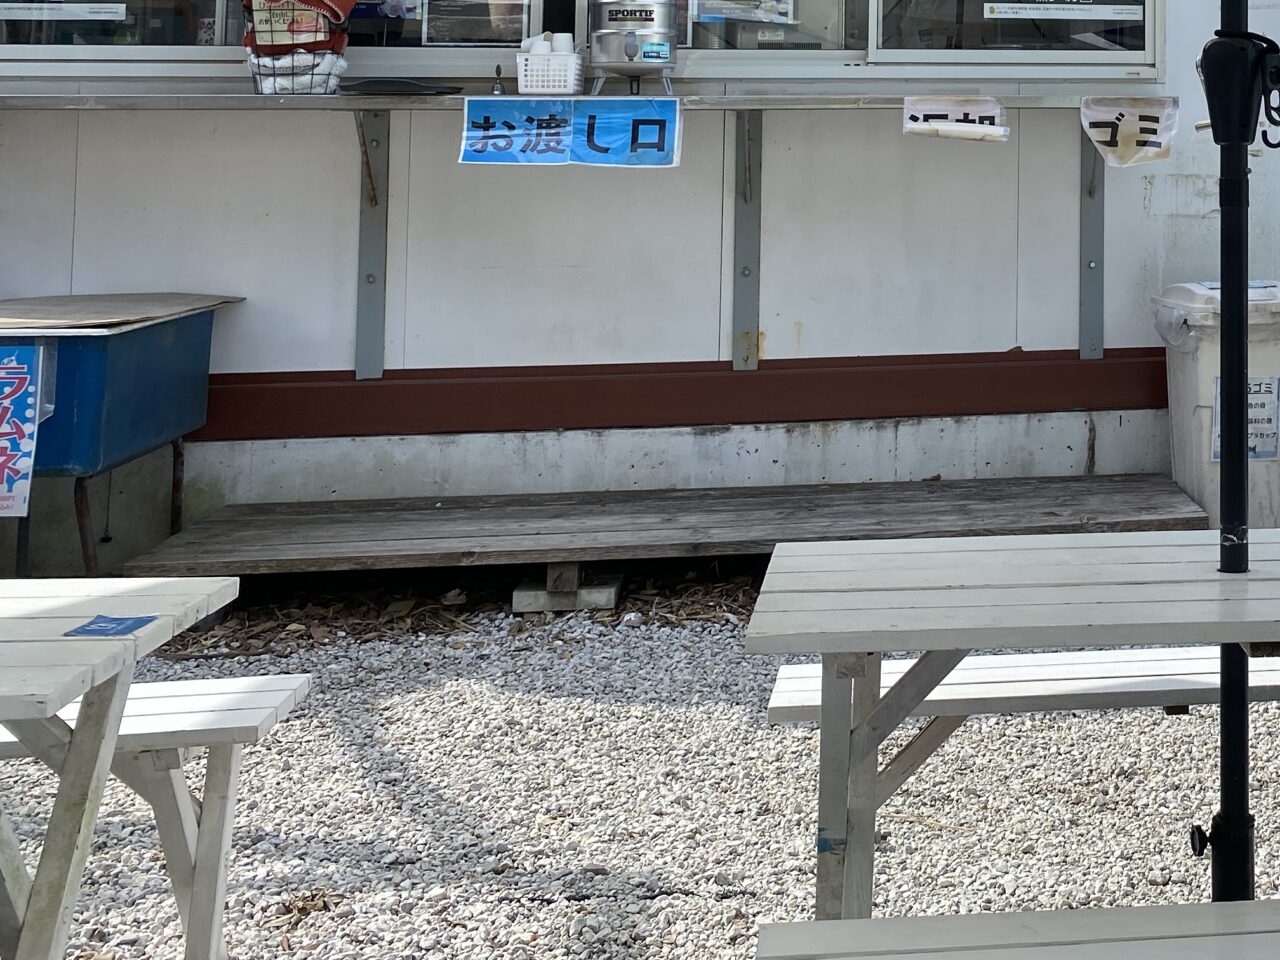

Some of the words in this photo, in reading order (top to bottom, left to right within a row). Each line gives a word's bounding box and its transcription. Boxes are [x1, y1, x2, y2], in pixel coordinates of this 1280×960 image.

[608, 9, 655, 17] SPORTIF
[469, 113, 667, 155] お渡し口
[1088, 112, 1162, 149] ゴミ
